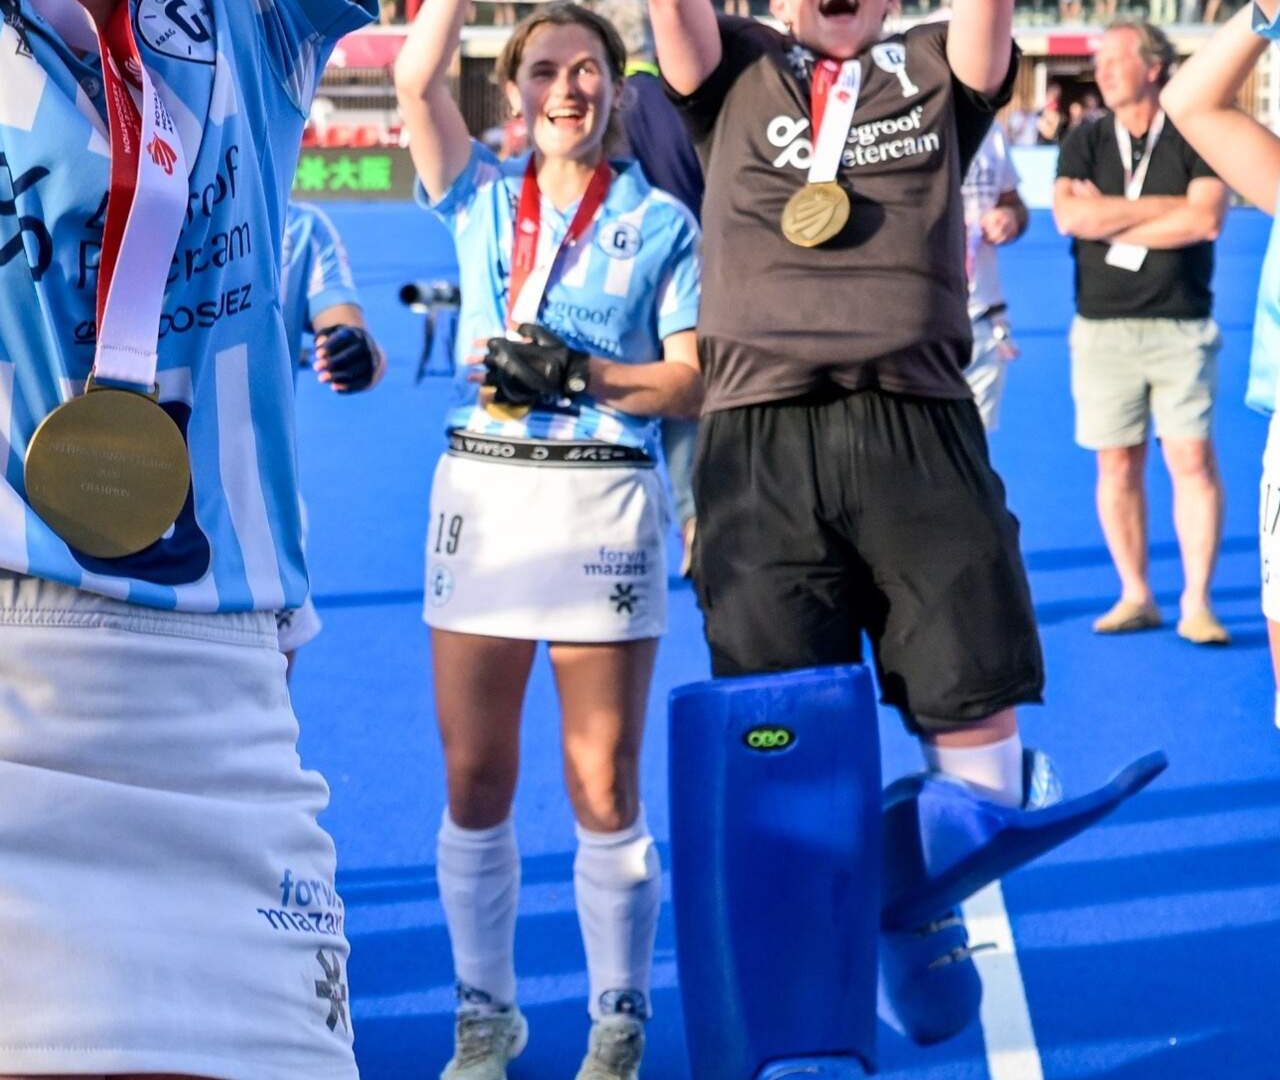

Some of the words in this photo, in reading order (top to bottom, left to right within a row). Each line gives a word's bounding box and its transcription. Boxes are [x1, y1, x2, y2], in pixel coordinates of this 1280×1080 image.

[848, 106, 924, 146] egroof
[841, 133, 940, 168] etercam
[434, 512, 464, 556] 19
[747, 729, 790, 748] OBO
